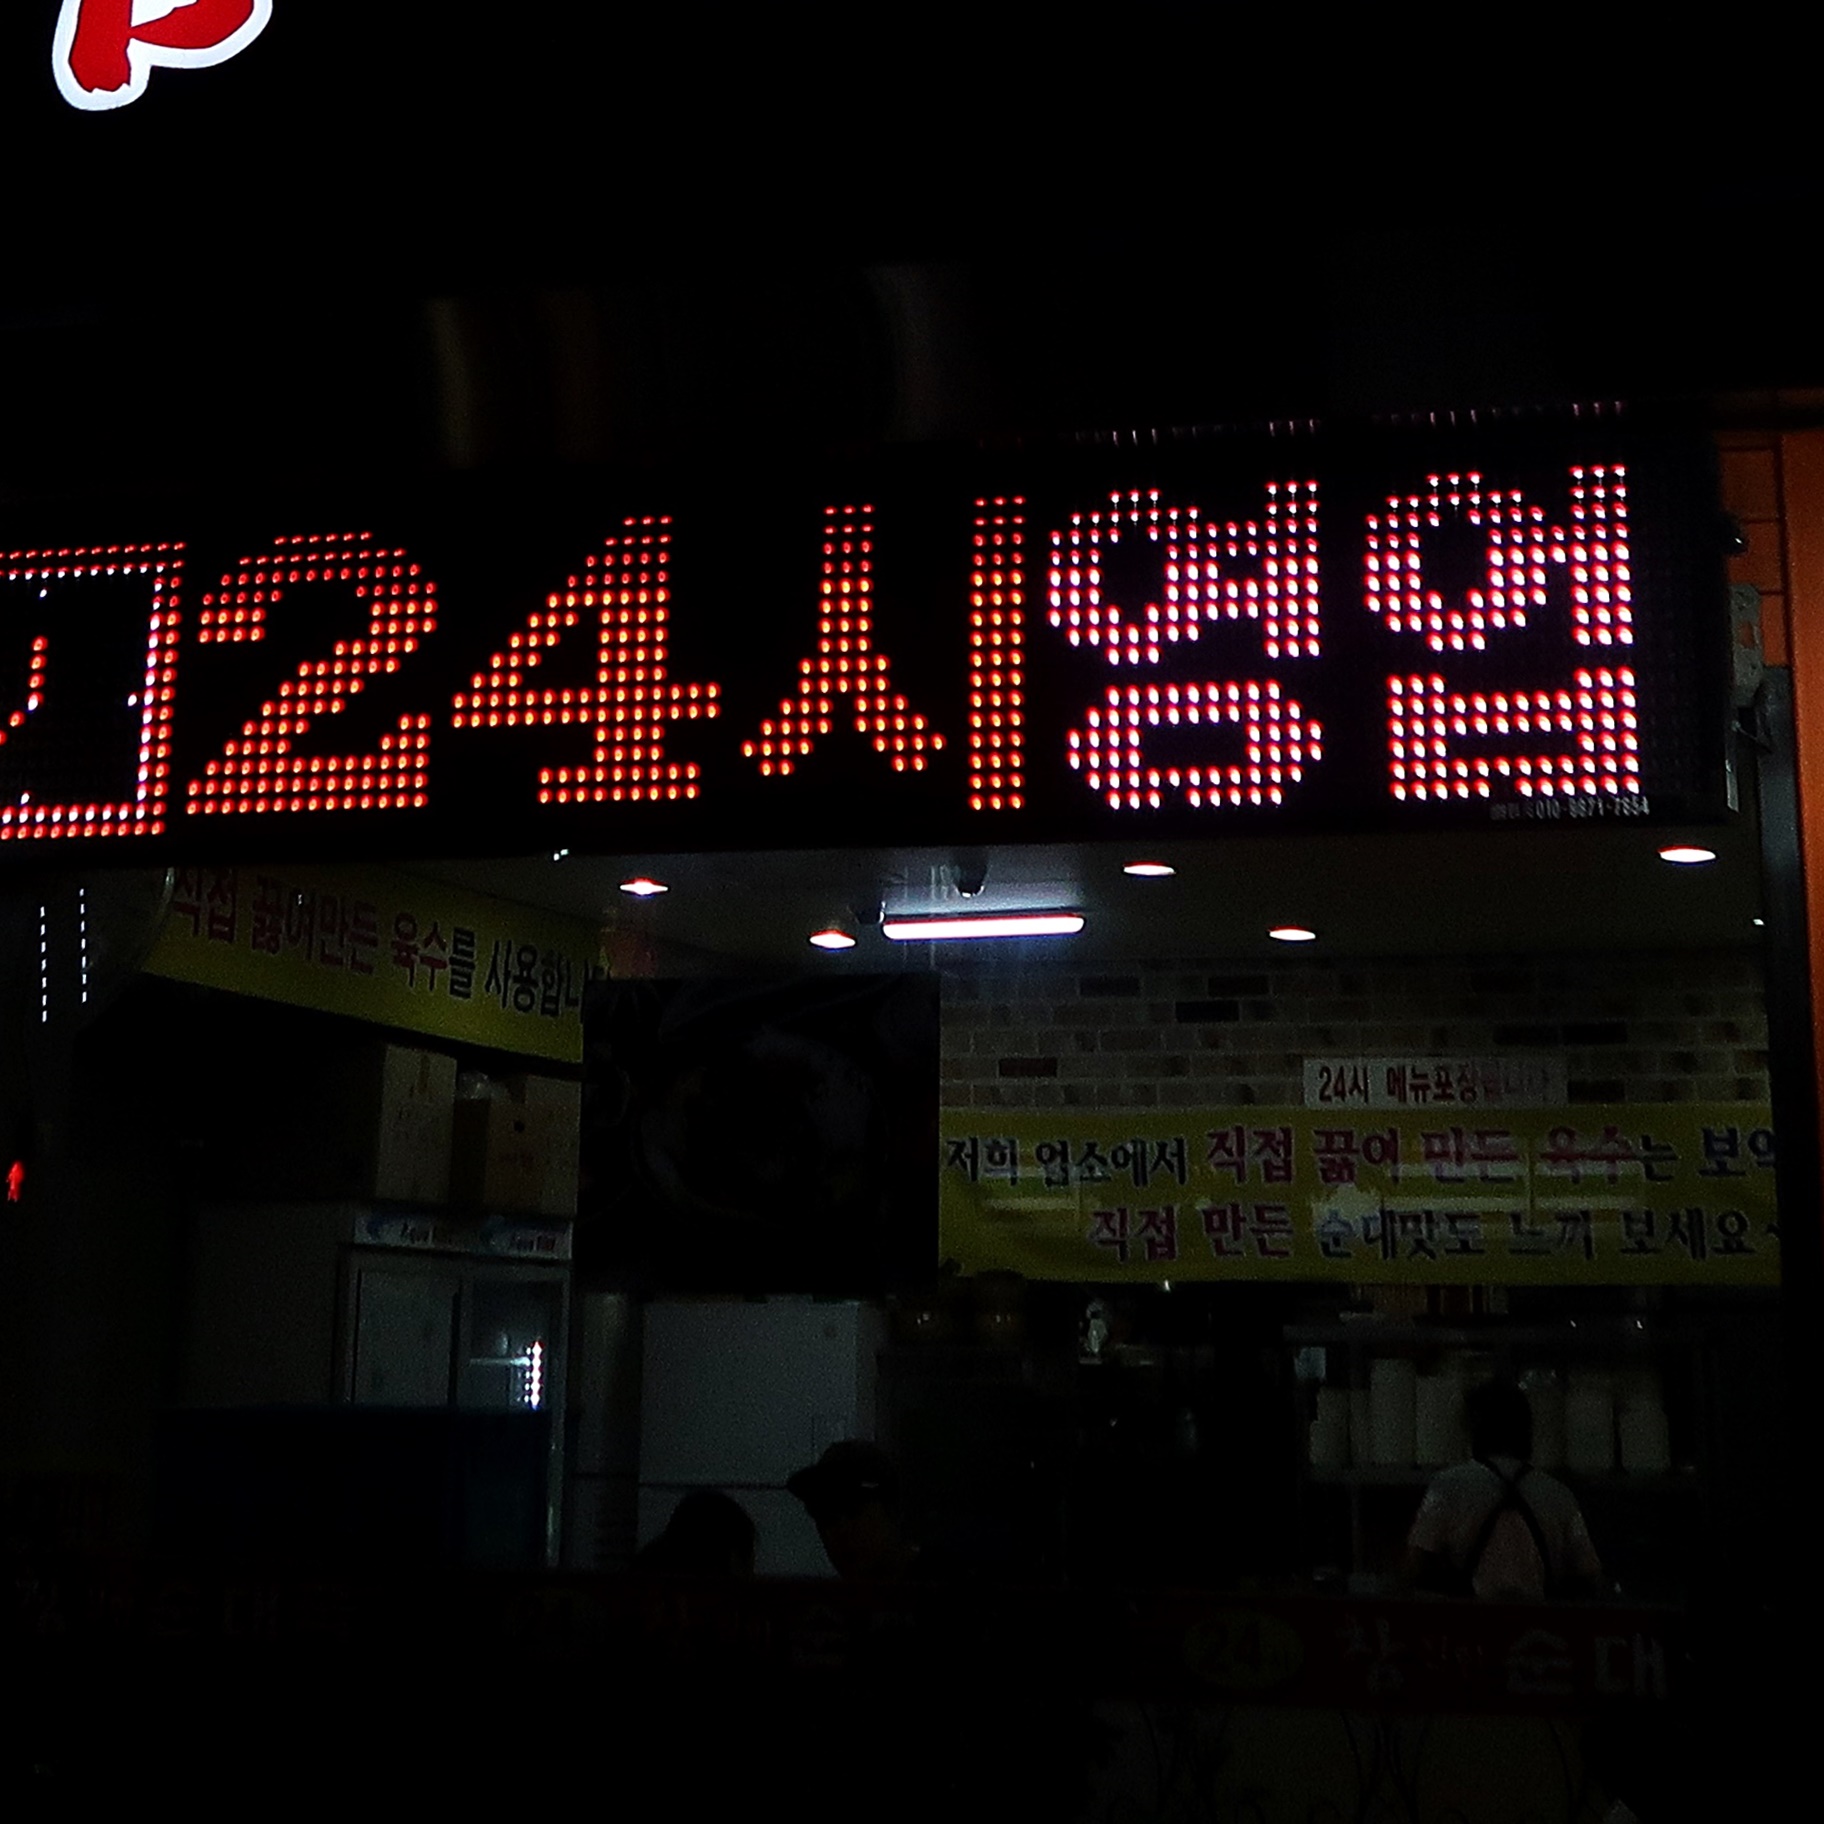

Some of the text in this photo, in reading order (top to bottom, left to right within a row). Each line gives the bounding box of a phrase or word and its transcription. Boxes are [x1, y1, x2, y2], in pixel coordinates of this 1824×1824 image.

[391, 911, 476, 1000] 육수를
[1318, 1064, 1369, 1104] 24시
[945, 1136, 1018, 1185] 저희
[1035, 1136, 1186, 1187] 업소에서
[1206, 1125, 1294, 1184] 직접
[1313, 1127, 1400, 1185] 끓여
[1090, 1204, 1178, 1263] 직접
[1200, 1202, 1295, 1257] 만든
[1316, 1206, 1485, 1260] 순대맛도
